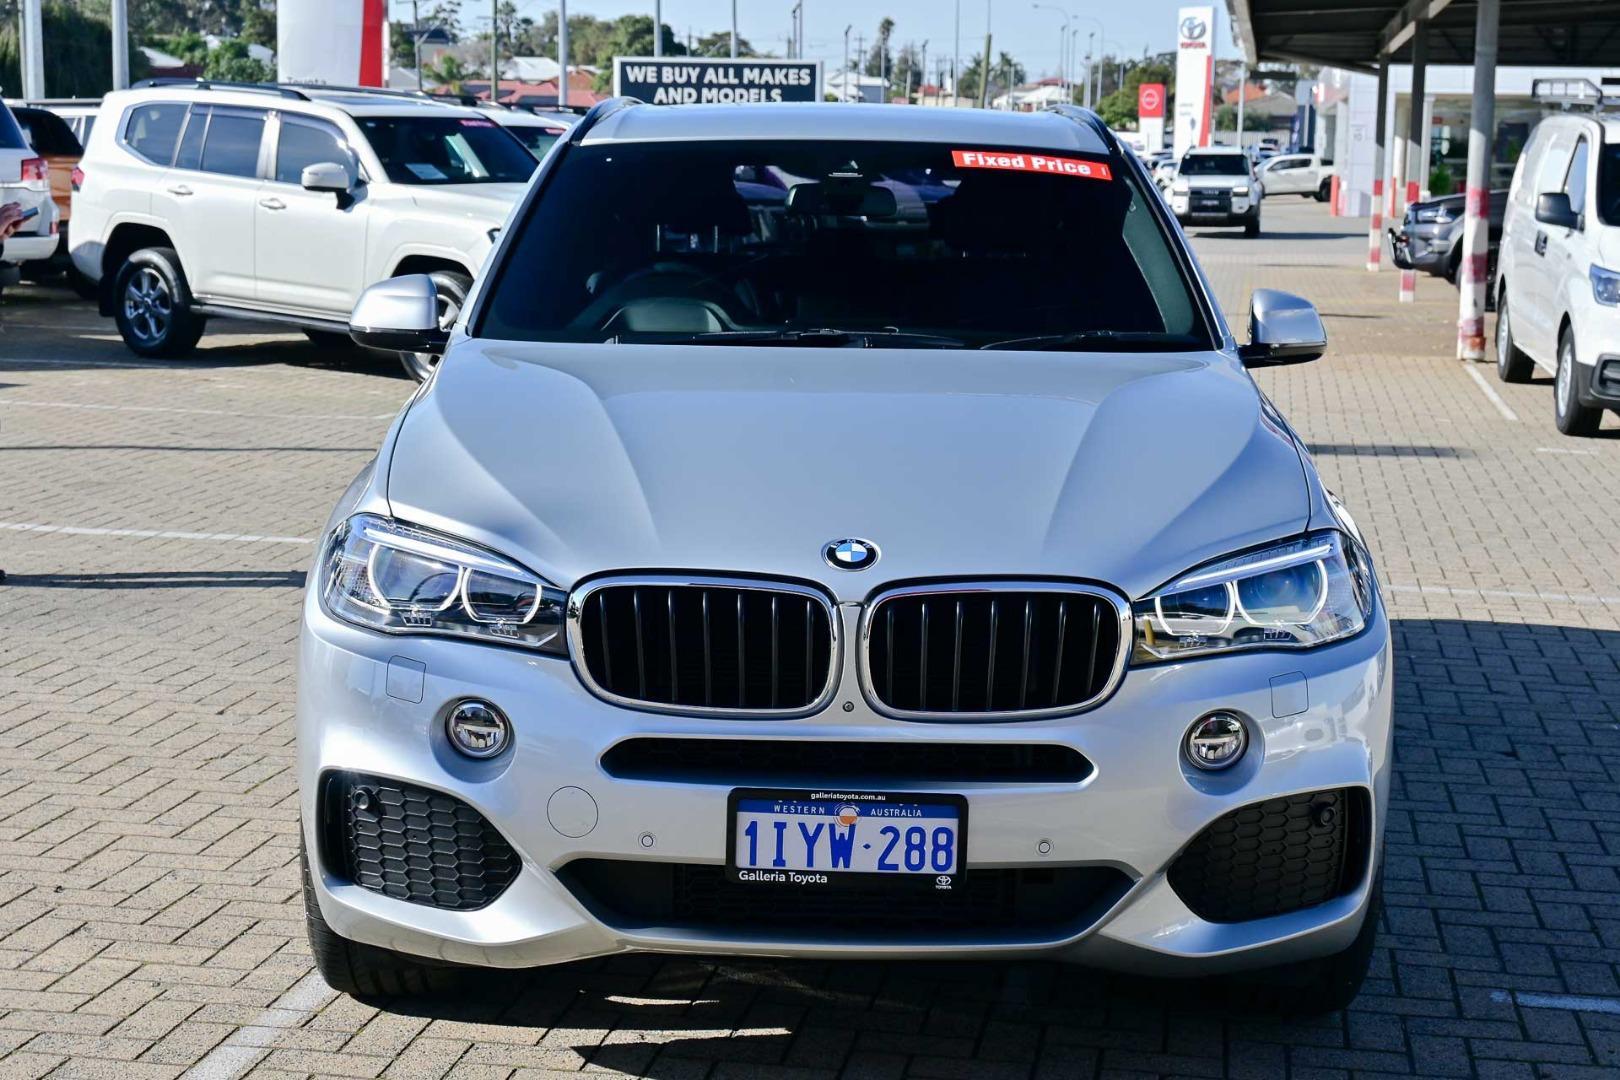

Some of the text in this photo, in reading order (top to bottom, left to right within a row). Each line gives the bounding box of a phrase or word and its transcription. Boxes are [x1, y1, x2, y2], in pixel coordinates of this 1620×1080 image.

[625, 65, 811, 86] WE BUY ALL MAKES
[653, 87, 783, 104] AND MODELS
[962, 152, 1091, 175] Fixed Price
[810, 792, 886, 801] galleriatoyota.com.au
[774, 804, 922, 817] WESTERN AUSTRALIA
[738, 870, 828, 885] Galleria Toyota
